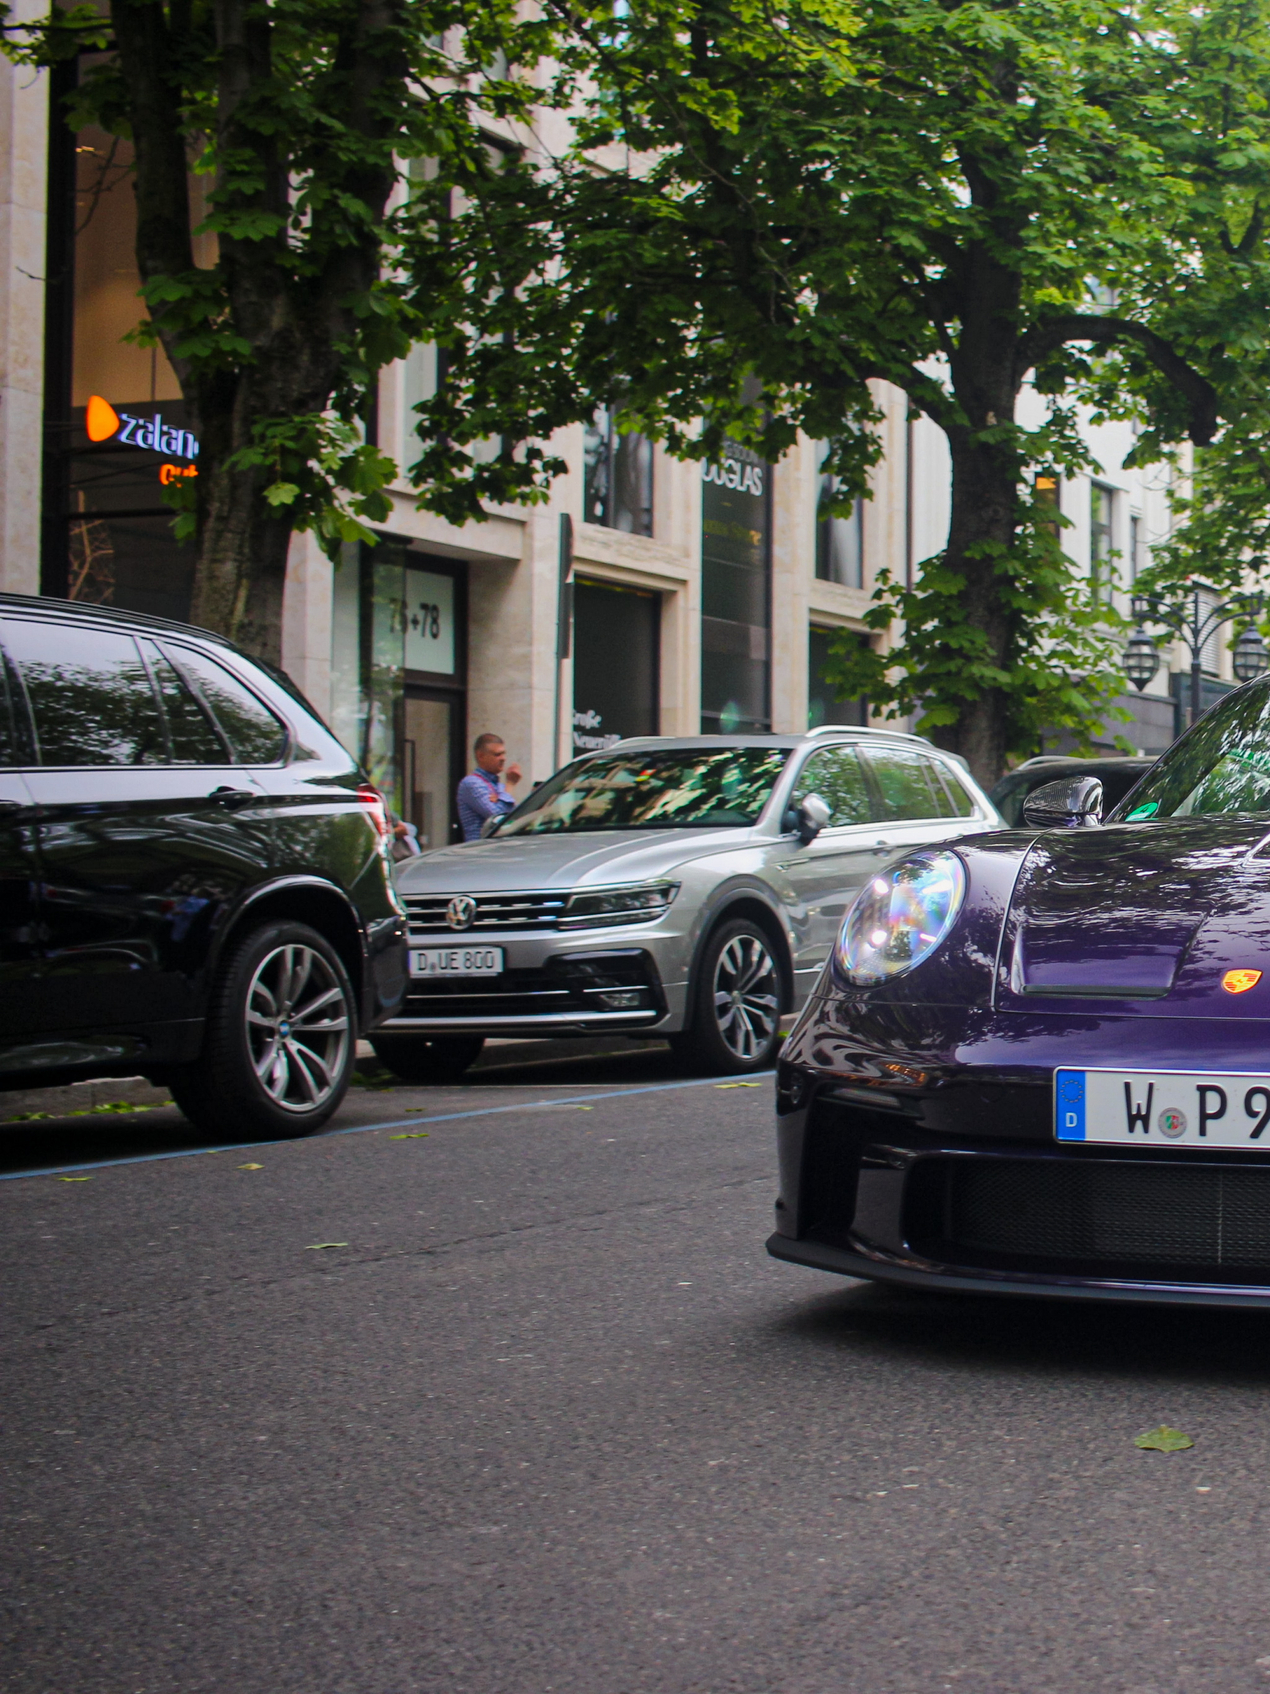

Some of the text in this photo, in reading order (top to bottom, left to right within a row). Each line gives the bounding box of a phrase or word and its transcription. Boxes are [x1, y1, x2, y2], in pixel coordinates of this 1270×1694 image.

[417, 950, 495, 971] D UE 800
[1123, 1080, 1155, 1134] W
[1196, 1082, 1229, 1137] P
[1065, 1112, 1078, 1128] D
